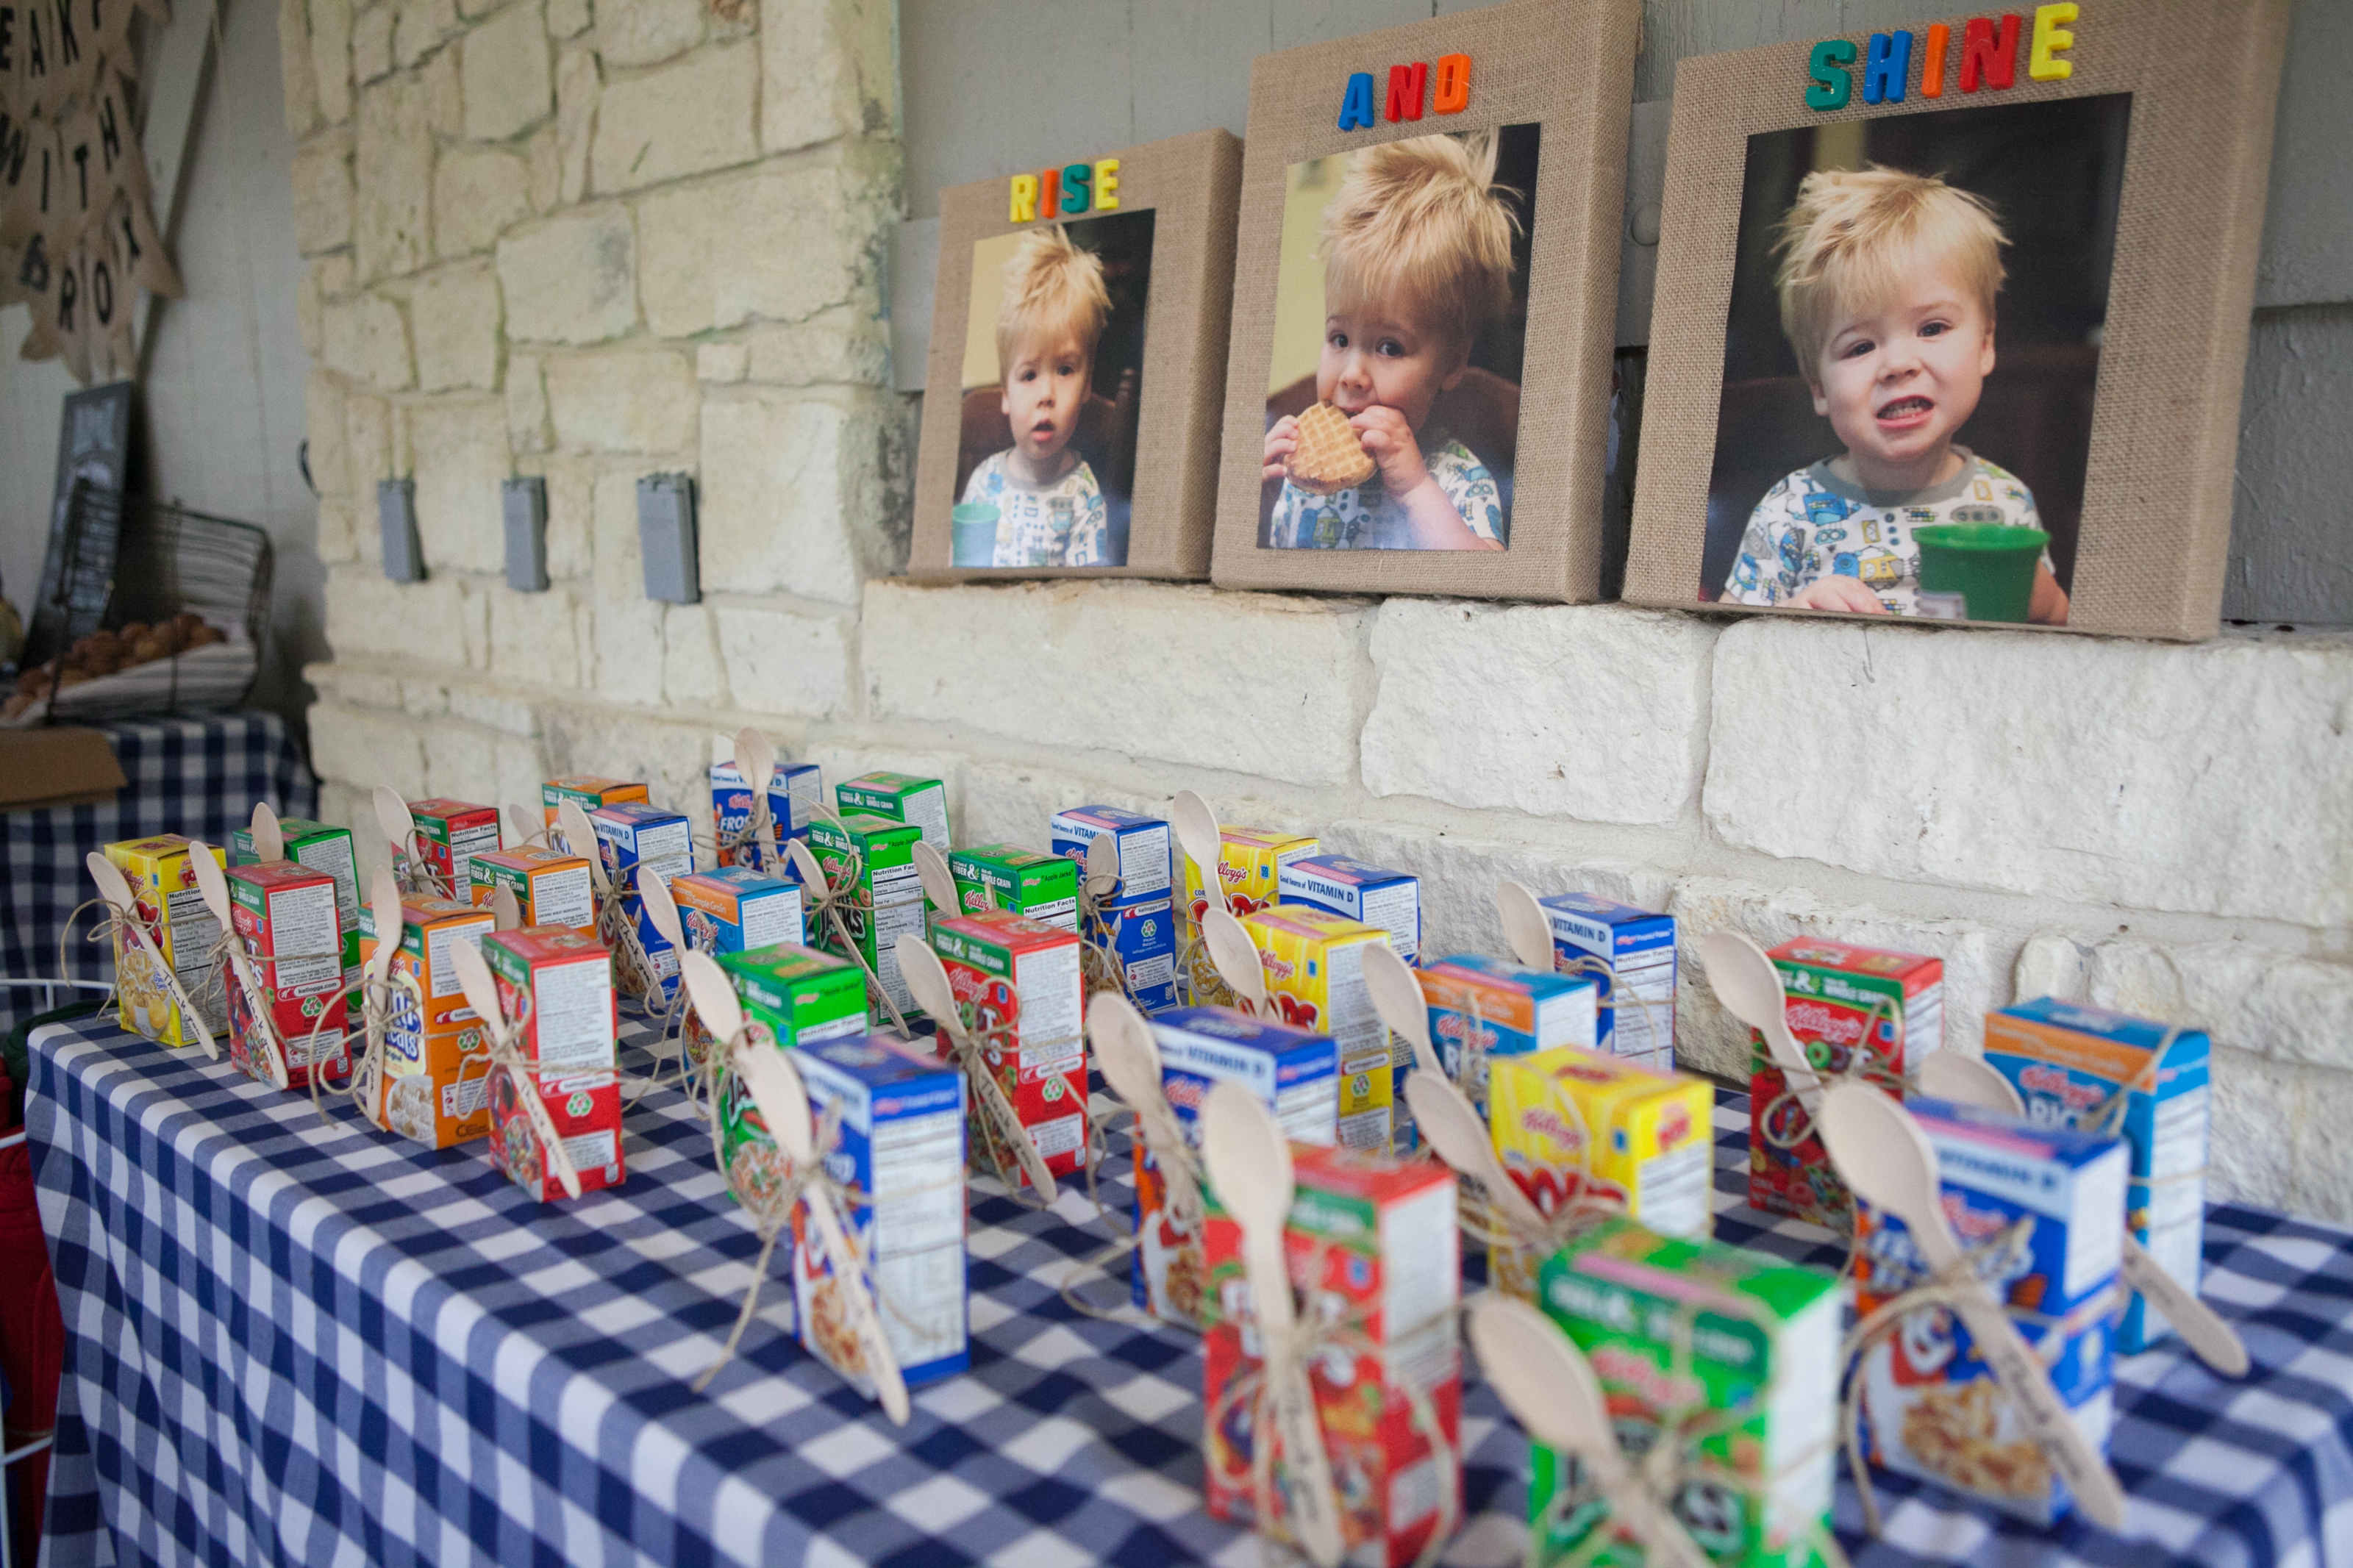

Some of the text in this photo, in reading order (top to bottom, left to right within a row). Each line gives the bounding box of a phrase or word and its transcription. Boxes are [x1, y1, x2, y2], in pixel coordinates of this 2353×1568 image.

[1805, 2, 2079, 112] SHINE
[1338, 53, 1471, 132] AND
[1010, 158, 1120, 223] RISE
[881, 801, 893, 809] GRAIN
[451, 824, 496, 839] Nutrition Facts
[599, 823, 629, 840] VITAMIN D
[1059, 824, 1068, 832] Source
[238, 841, 250, 851] FIBER
[813, 831, 833, 847] FIBER &
[835, 840, 848, 851] WHOLE
[471, 867, 492, 884] FIBER &
[873, 867, 902, 877] Nutrition
[953, 863, 979, 881] FIBER &
[1045, 872, 1057, 882] Apple
[510, 881, 525, 892] GRAIN
[981, 872, 1011, 889] WHOLE GRAIN
[673, 883, 693, 897] Goodness
[1279, 875, 1289, 883] Good
[1290, 878, 1302, 888] Source
[1307, 879, 1344, 901] VITAMIN
[1347, 891, 1354, 903] D
[238, 892, 260, 905] WHOLE GRAIN
[692, 895, 726, 914] Simple Grain
[1025, 899, 1075, 914] Nutrition Facts
[1138, 902, 1168, 913] kelloggs.com
[886, 922, 907, 931] Carbohydrate
[1553, 917, 1606, 942] VITAMIN D
[174, 936, 196, 944] Cholesterol
[619, 920, 638, 962] Thank
[186, 943, 210, 953] Carbohydrate
[1129, 954, 1172, 970] Questions Comments?
[1617, 949, 1673, 964] Nutrition Facts
[163, 969, 185, 1012] Thank
[298, 981, 337, 995] kelloggs.com
[245, 983, 263, 1035] Thank
[316, 1029, 341, 1039] Comments?
[979, 1073, 1010, 1131] Thank
